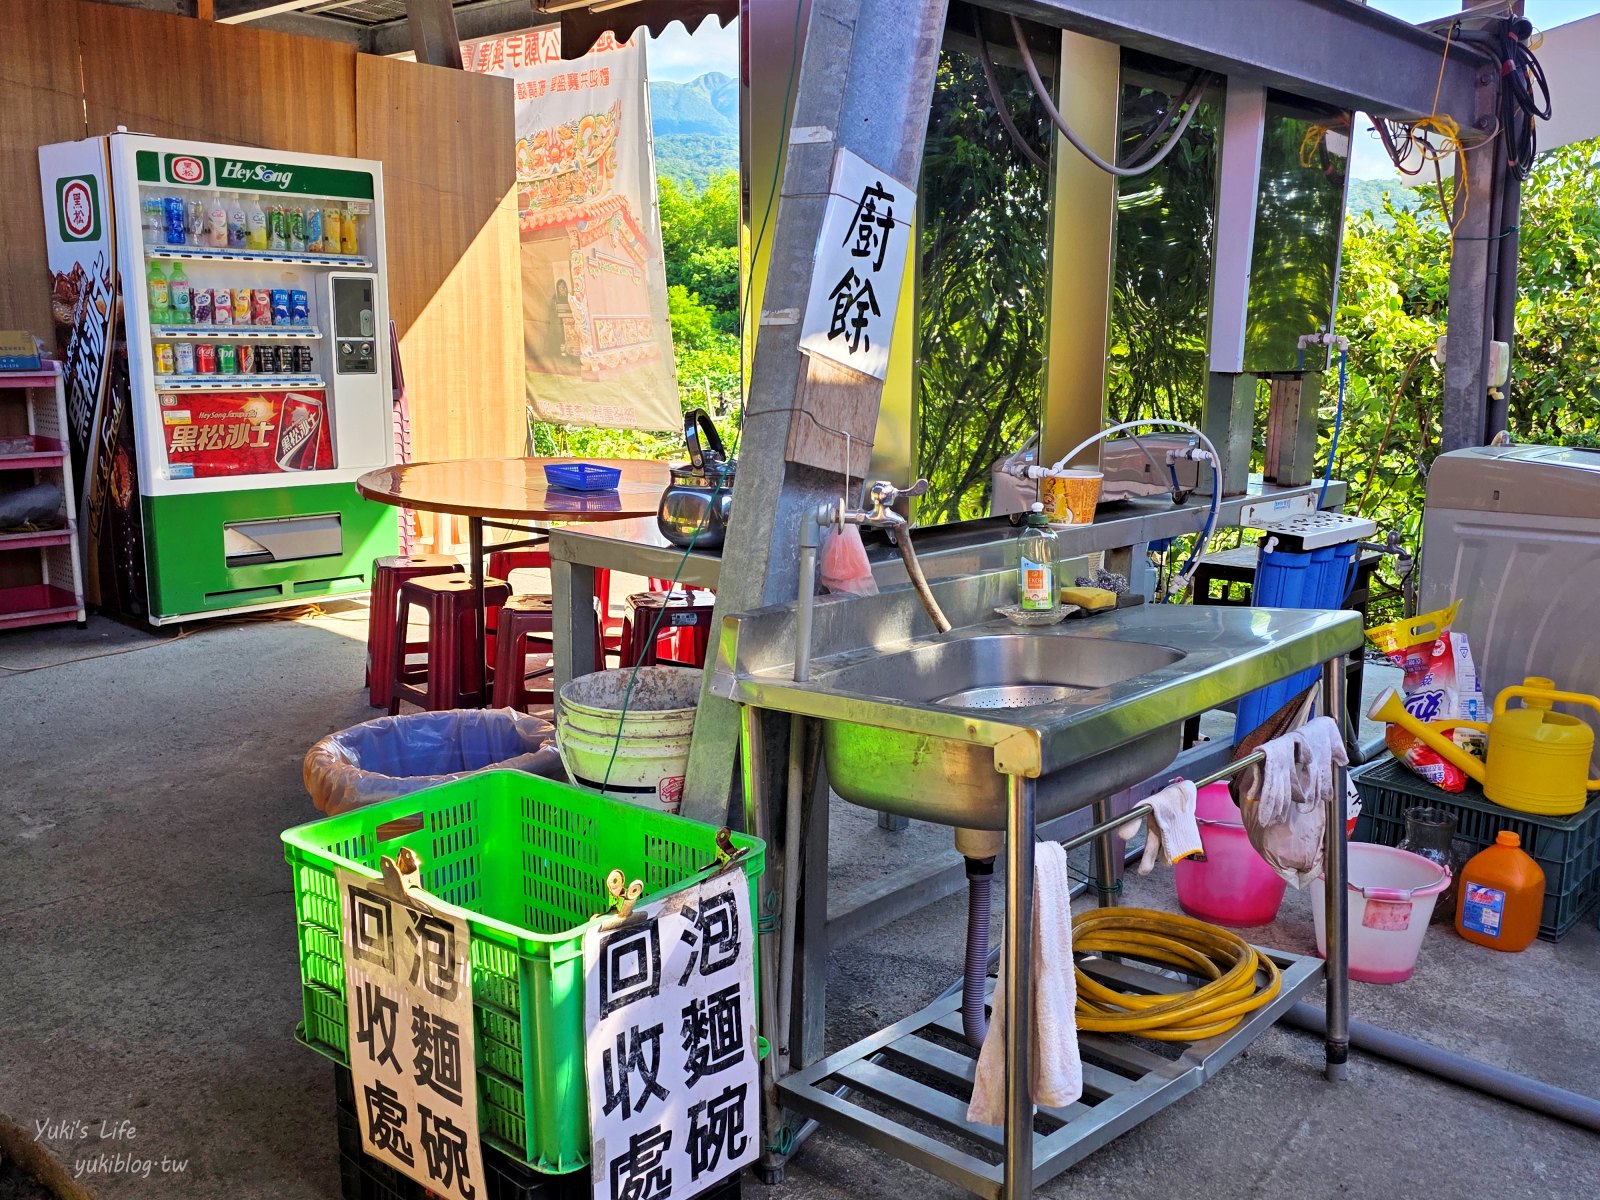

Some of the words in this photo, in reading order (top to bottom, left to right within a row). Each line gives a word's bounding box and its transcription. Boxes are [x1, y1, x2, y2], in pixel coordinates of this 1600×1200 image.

[72, 192, 85, 226] 黑松
[275, 293, 288, 301] FIN
[827, 180, 896, 355] 廚餘
[169, 421, 275, 454] 黑松沙士
[347, 884, 415, 1169] 回收處
[404, 907, 476, 1200] 泡麵碗
[599, 916, 673, 1200] 回收處
[677, 888, 749, 1182] 泡麵碗
